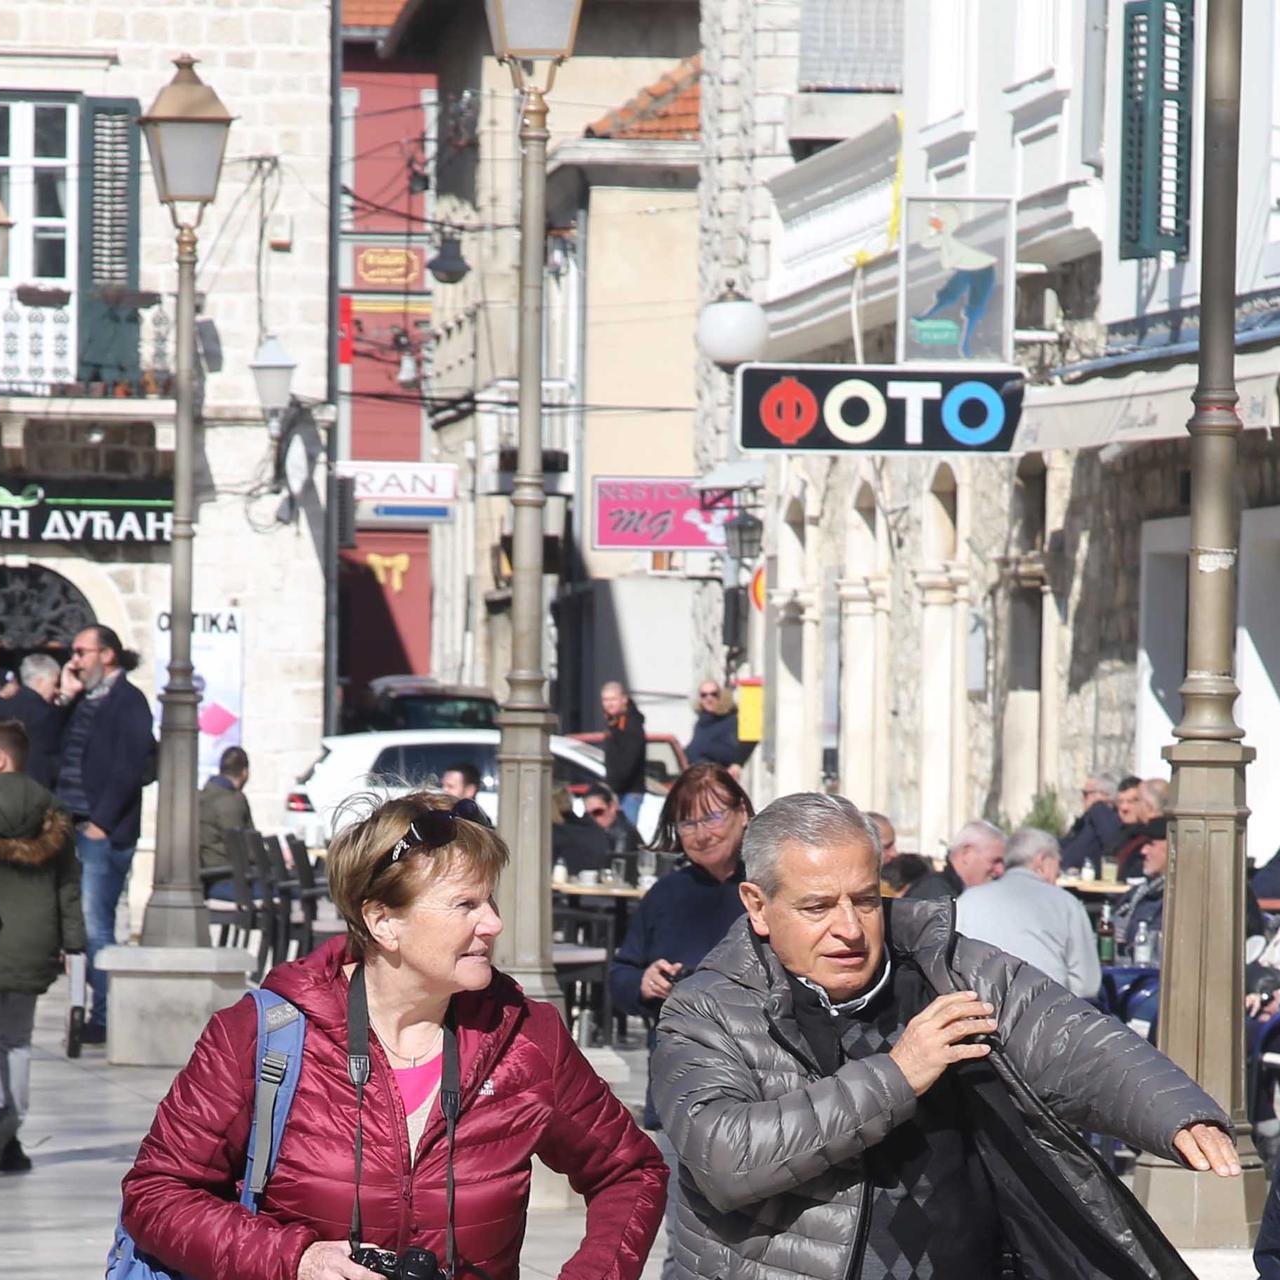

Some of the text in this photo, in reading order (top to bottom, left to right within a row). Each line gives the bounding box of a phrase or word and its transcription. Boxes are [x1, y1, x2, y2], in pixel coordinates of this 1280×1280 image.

[759, 376, 1006, 445] ФОТО
[41, 511, 174, 542] ДУЋАН
[158, 611, 239, 633] OTIKA
